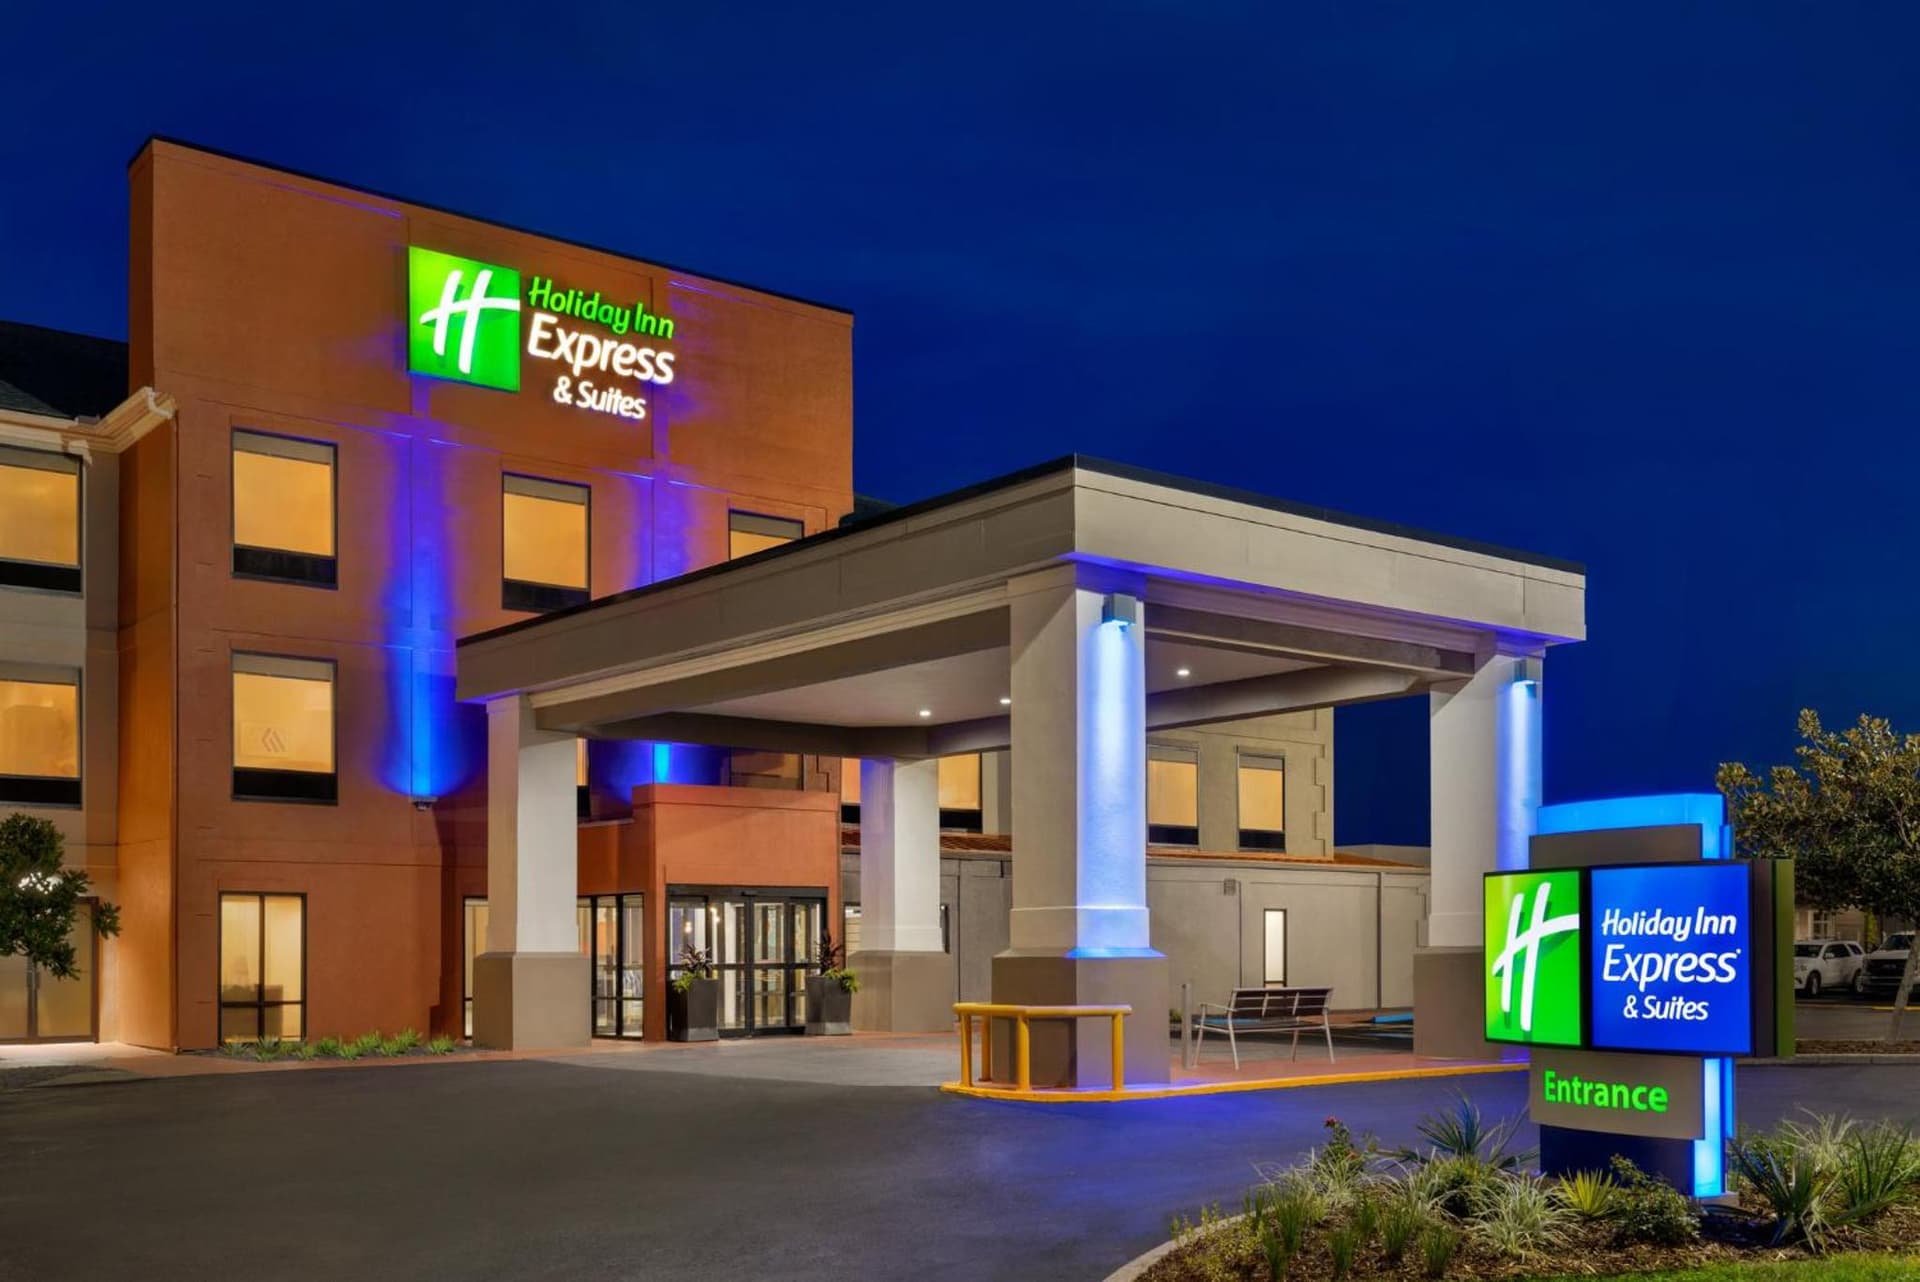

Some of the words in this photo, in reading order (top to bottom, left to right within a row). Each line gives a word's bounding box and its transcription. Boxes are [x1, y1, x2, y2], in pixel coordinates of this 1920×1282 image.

[528, 276, 632, 335] Holiday
[634, 302, 675, 339] Inn
[527, 311, 675, 385] Express
[552, 375, 573, 405] &
[576, 380, 647, 420] Suites
[1601, 908, 1692, 942] Holiday
[1694, 906, 1737, 936] Inn
[1602, 943, 1738, 993] Express
[1622, 995, 1639, 1019] &
[1642, 995, 1709, 1021] Suites
[1543, 1070, 1669, 1113] Entrance
